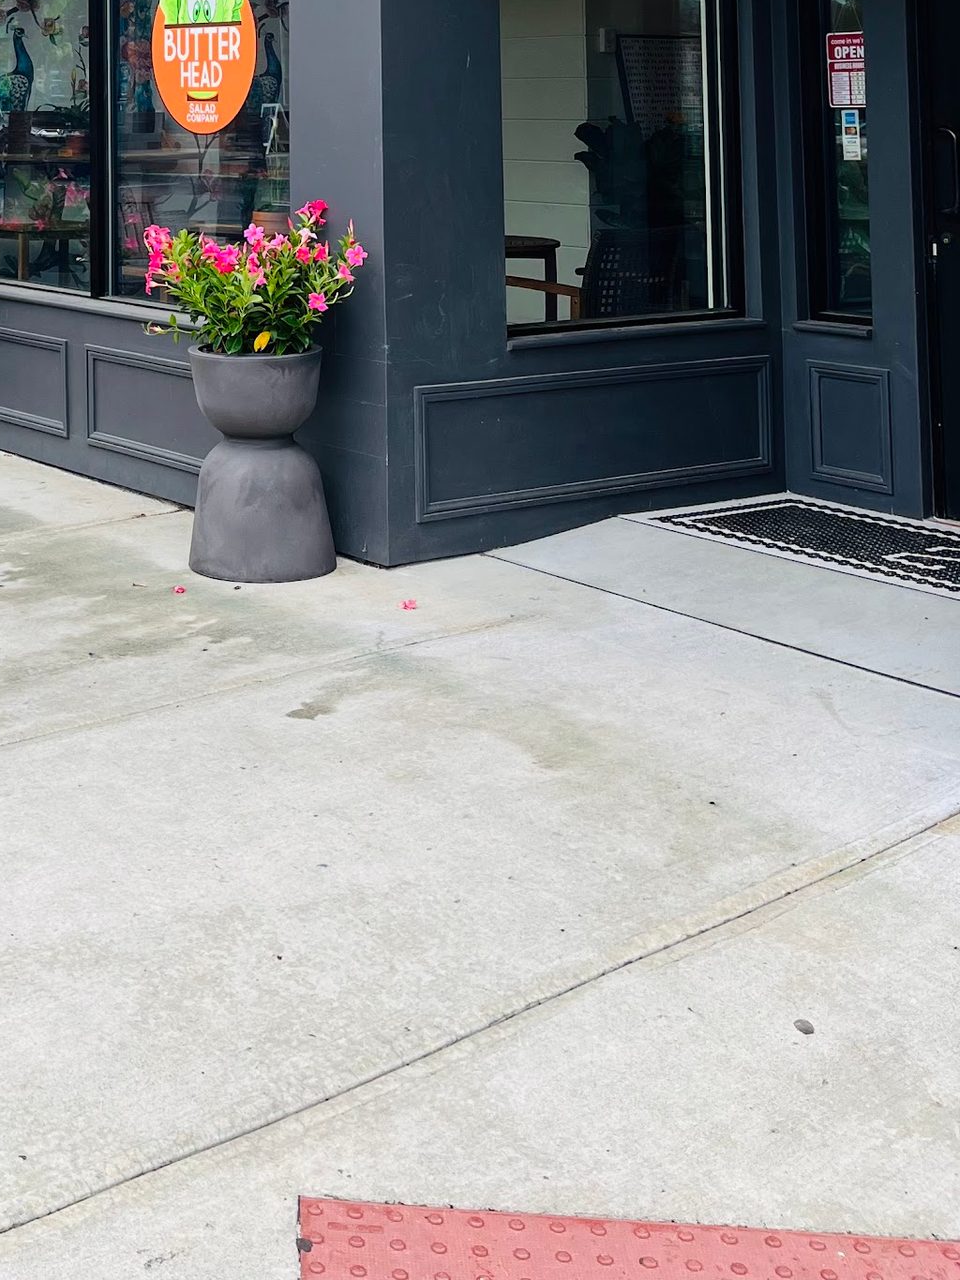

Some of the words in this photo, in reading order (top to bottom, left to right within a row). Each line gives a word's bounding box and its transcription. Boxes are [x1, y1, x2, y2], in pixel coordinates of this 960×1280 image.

[164, 27, 240, 62] BUTTER
[834, 46, 864, 59] OPEN
[180, 61, 223, 88] HEAD
[189, 103, 216, 113] SALAD
[186, 114, 219, 123] COMPANY
